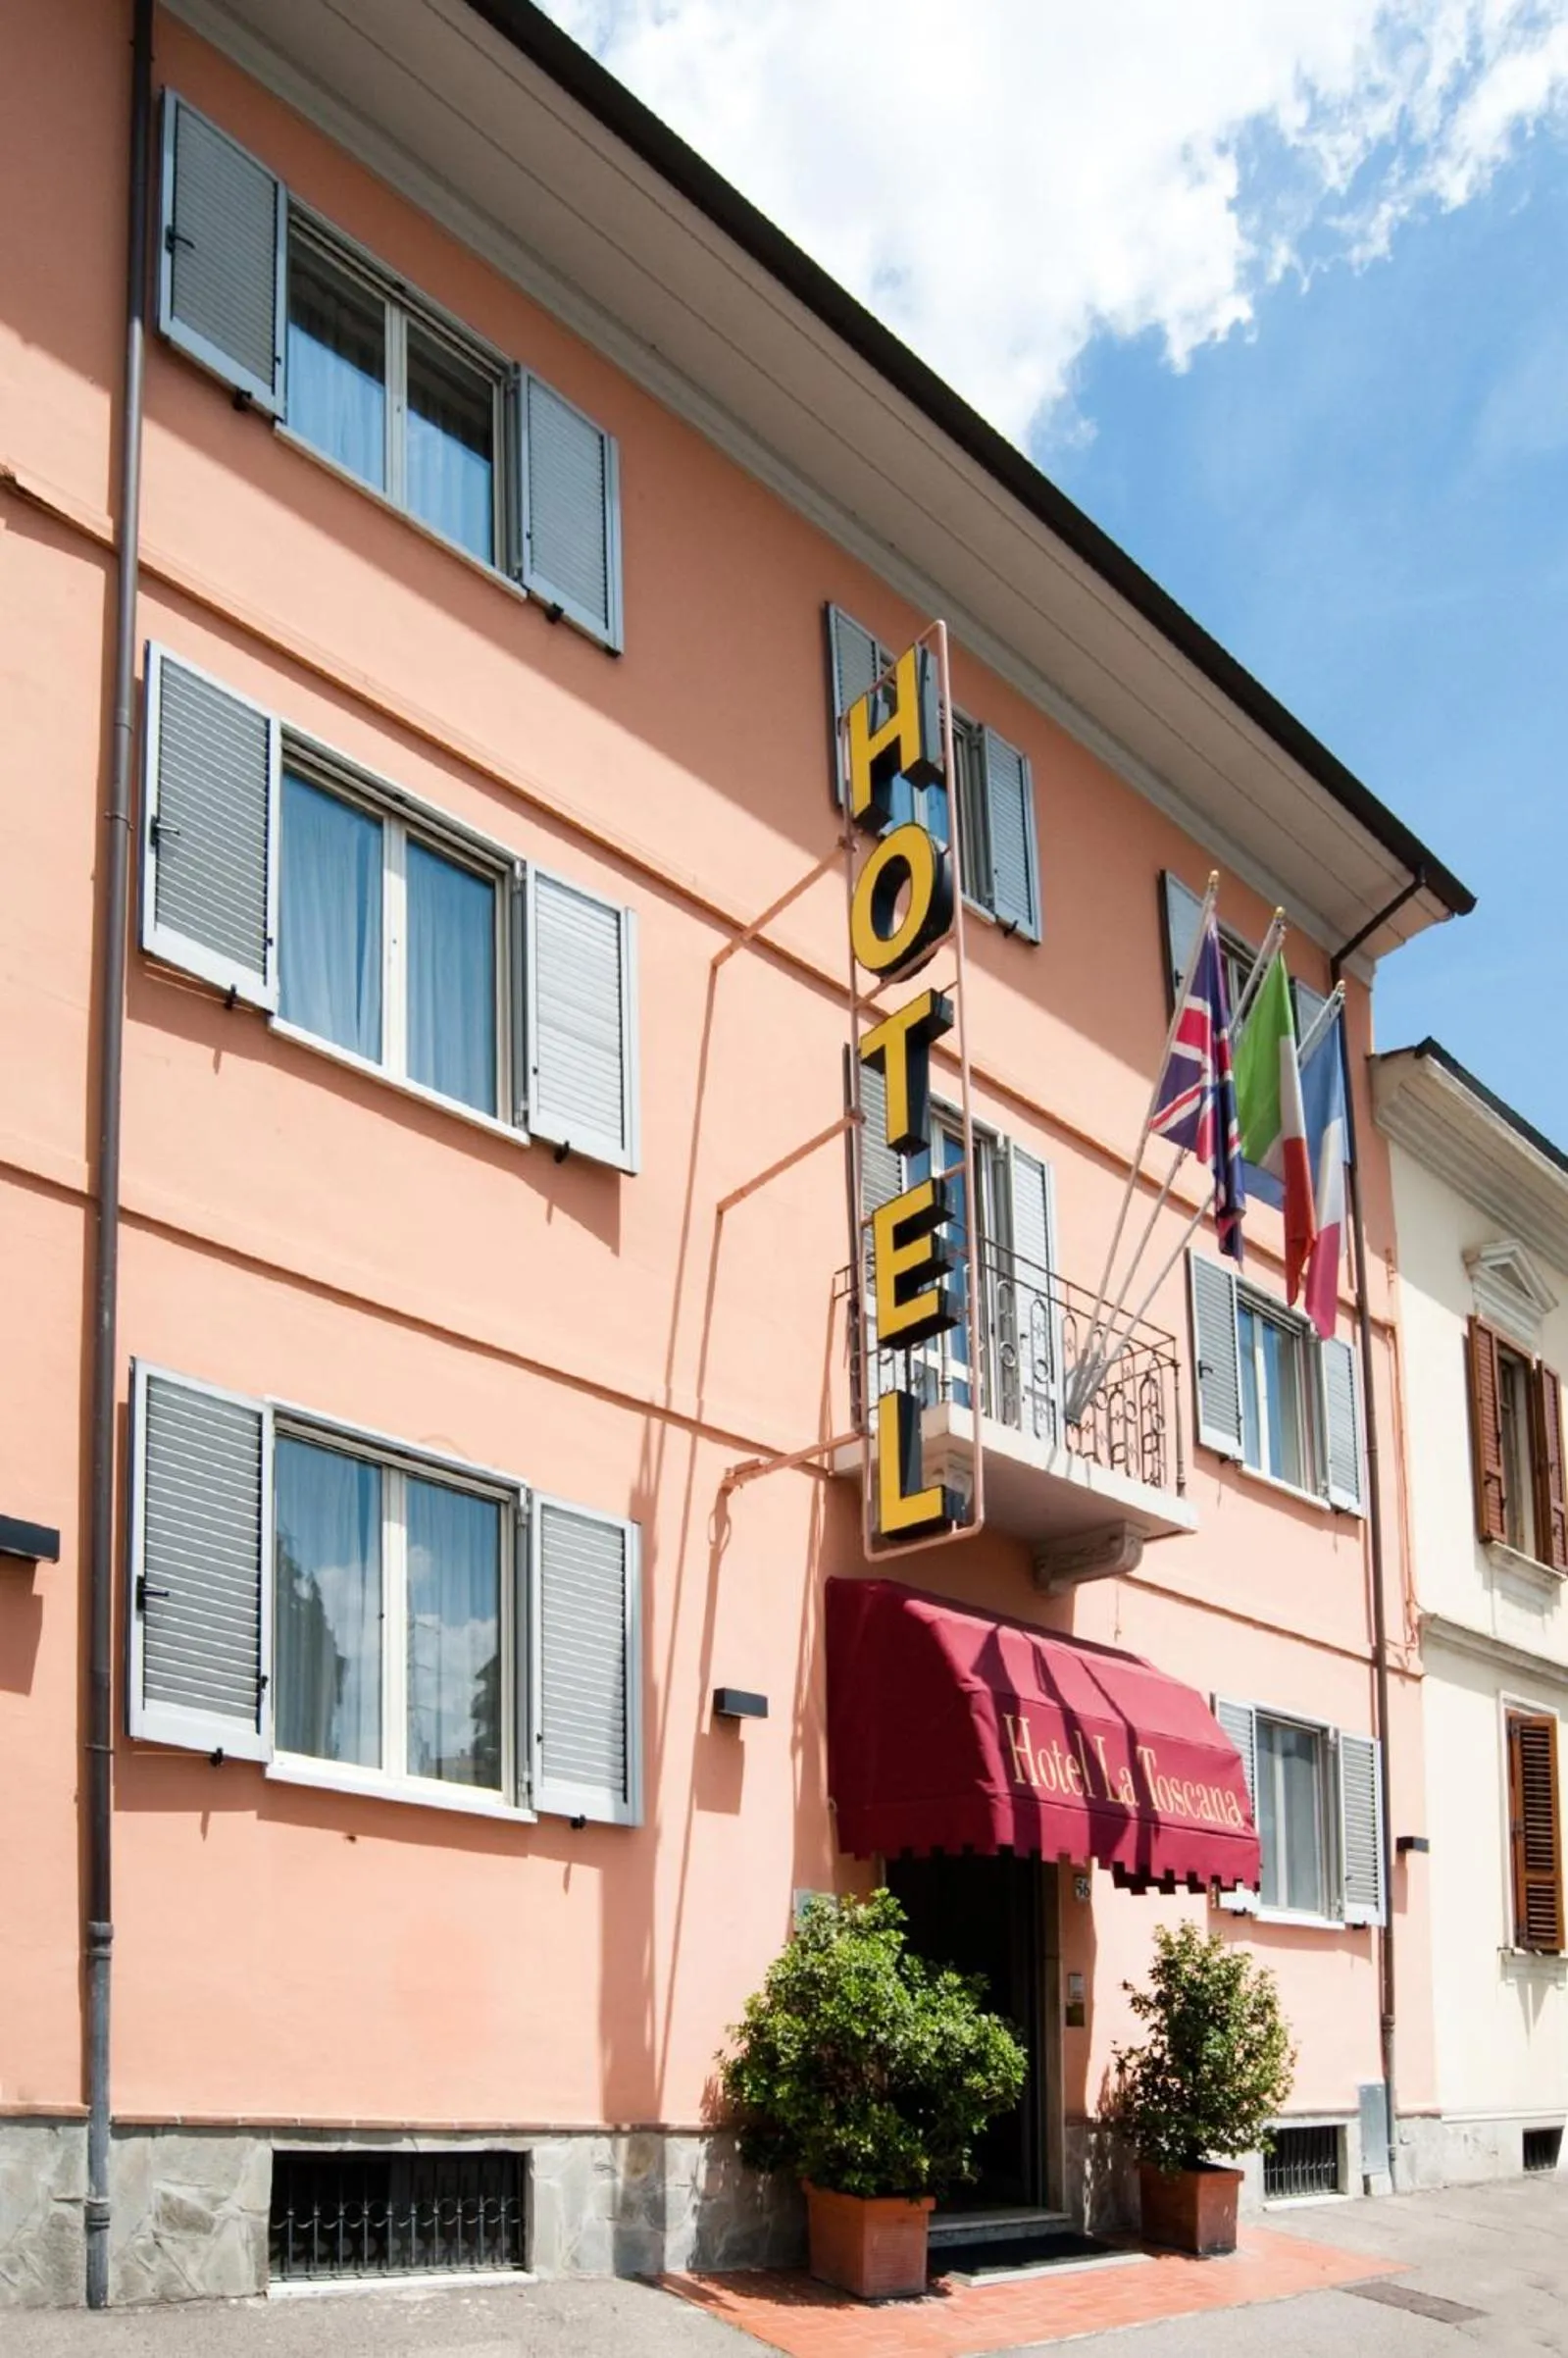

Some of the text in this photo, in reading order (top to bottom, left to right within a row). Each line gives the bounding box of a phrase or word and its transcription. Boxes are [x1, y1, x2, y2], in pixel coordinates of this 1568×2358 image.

[848, 643, 970, 1538] HOTEL
[1003, 1714, 1243, 1827] Hotel La Toscana
